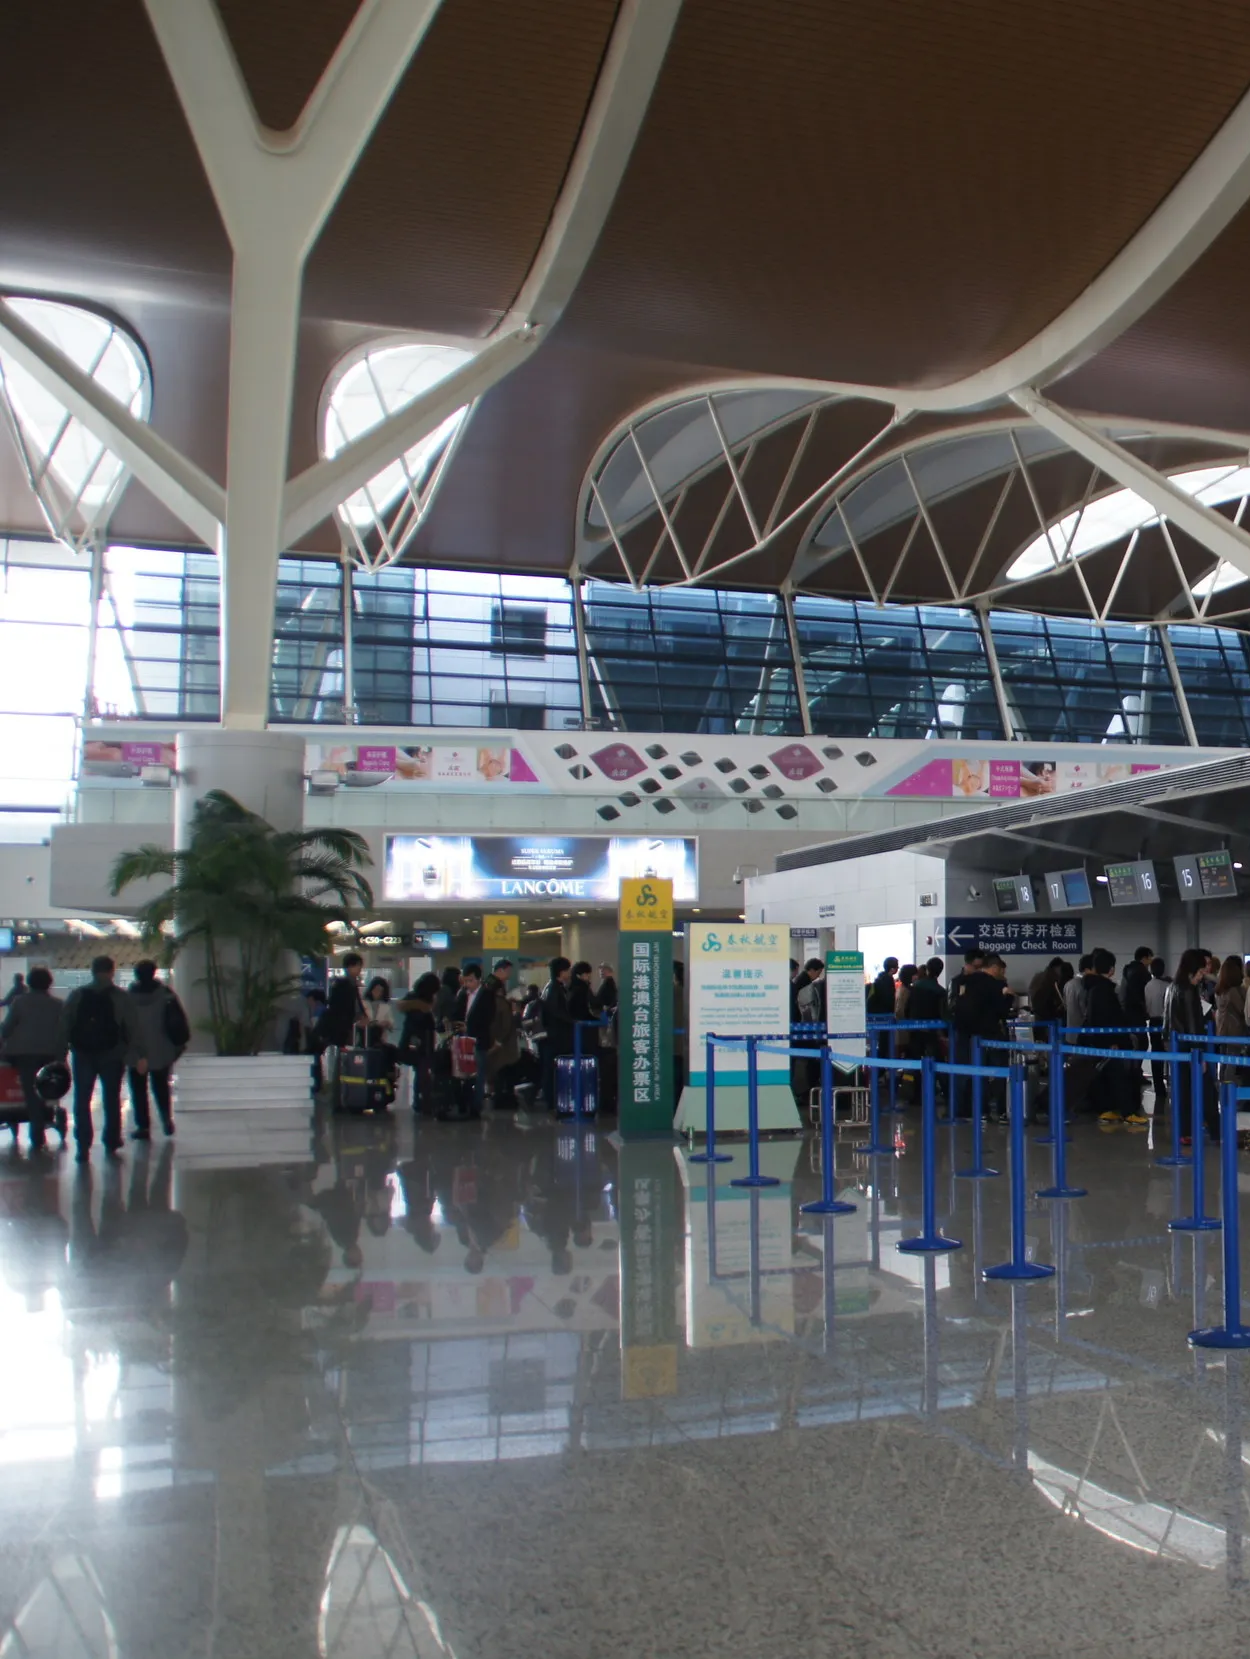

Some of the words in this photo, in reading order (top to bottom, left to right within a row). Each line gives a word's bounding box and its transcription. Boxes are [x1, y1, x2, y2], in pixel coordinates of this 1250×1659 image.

[1141, 872, 1152, 890] 16
[1182, 868, 1193, 887] 15
[502, 878, 585, 896] LANCÔME
[1020, 886, 1030, 902] 18
[1050, 883, 1059, 900] 17
[978, 924, 1077, 938] 交运行李开检室
[978, 941, 1016, 951] Baggage
[1022, 941, 1047, 950] Check
[1052, 941, 1077, 950] Room
[632, 942, 651, 1103] 国际港澳台旅客办票区
